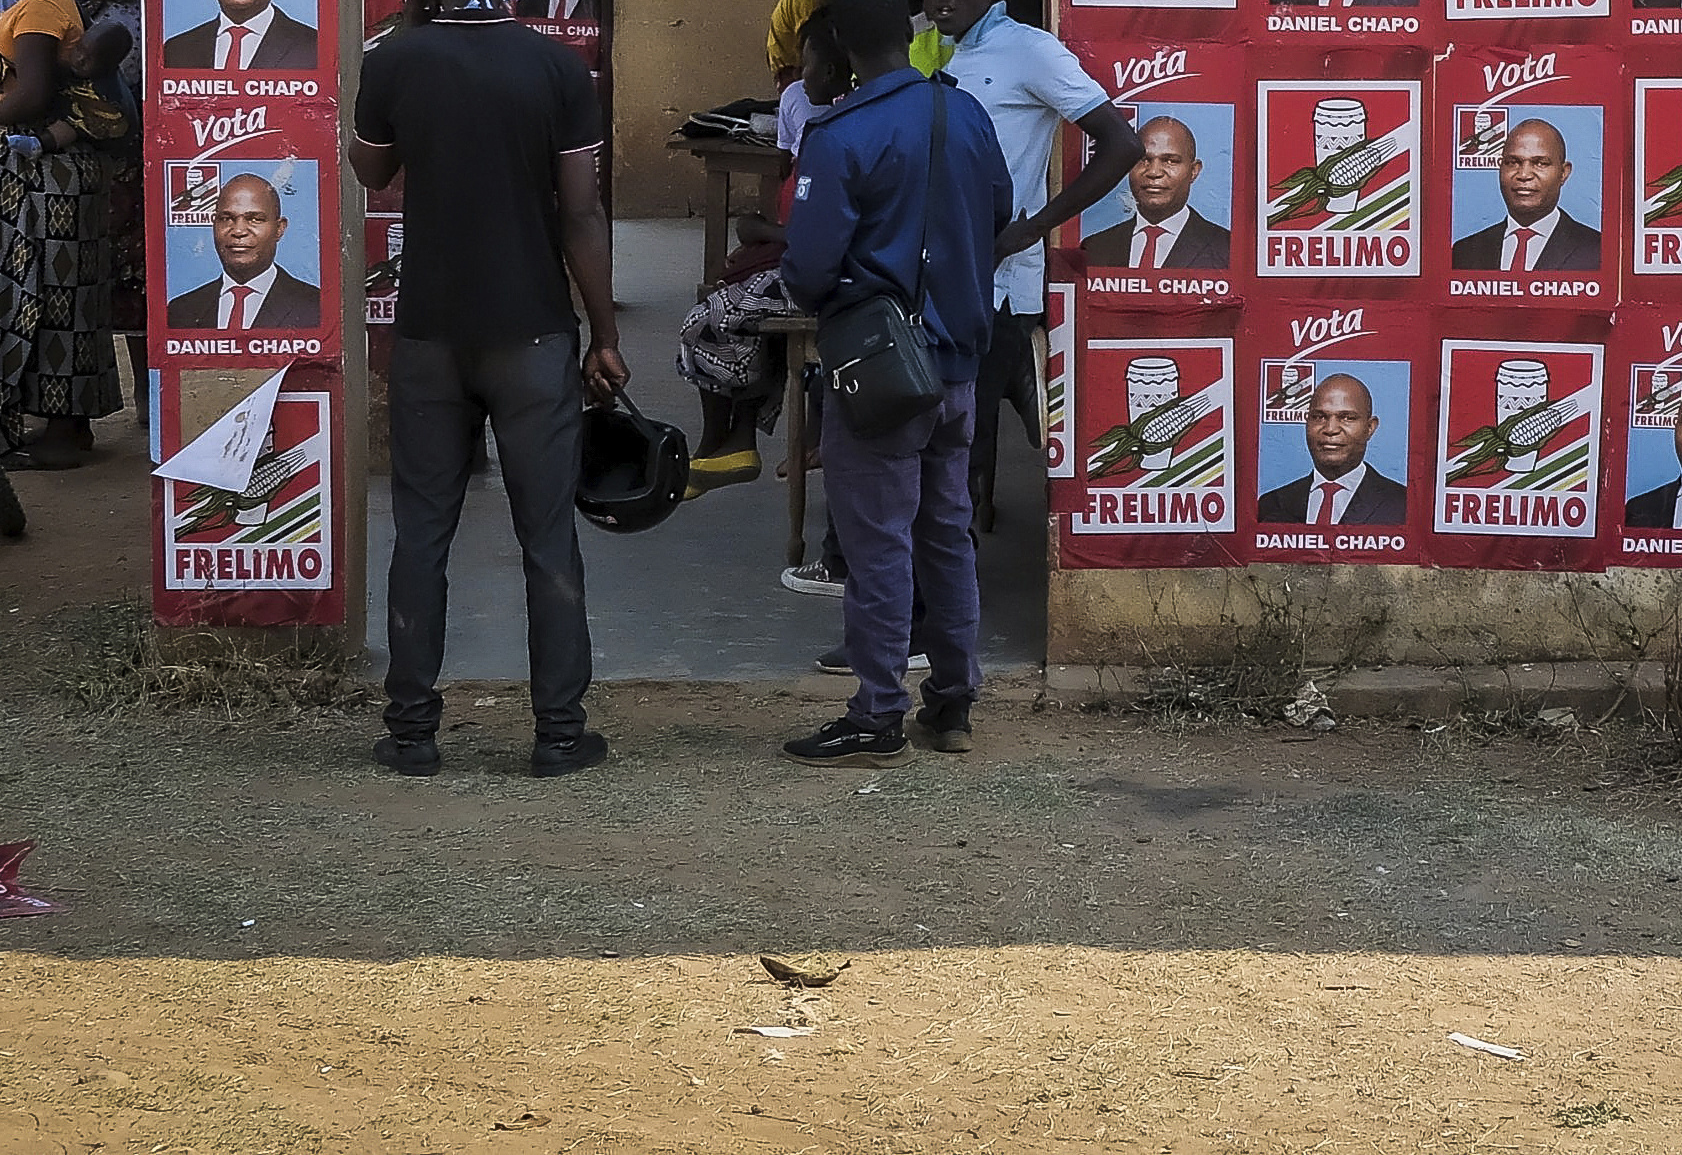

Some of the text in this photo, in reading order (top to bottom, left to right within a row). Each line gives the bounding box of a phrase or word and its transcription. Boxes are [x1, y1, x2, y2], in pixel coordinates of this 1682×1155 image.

[1268, 17, 1418, 32] DANIEL CHAPO
[1114, 49, 1186, 88] Vota
[1484, 53, 1555, 92] Vota
[164, 80, 317, 95] DANIEL CHAPO
[193, 106, 266, 146] Vota
[1268, 236, 1410, 266] FRELIMO
[1088, 278, 1228, 294] ANIEL CHAPO
[1451, 281, 1599, 296] DANIEL CHAPO
[1291, 309, 1363, 346] Vota
[167, 340, 320, 354] DANIEL CHAPO
[1083, 494, 1224, 524] FRELIMO
[1445, 493, 1586, 527] FRELIMO
[1257, 535, 1405, 550] DANIEL CHAPO
[176, 549, 322, 580] FRELIMO
